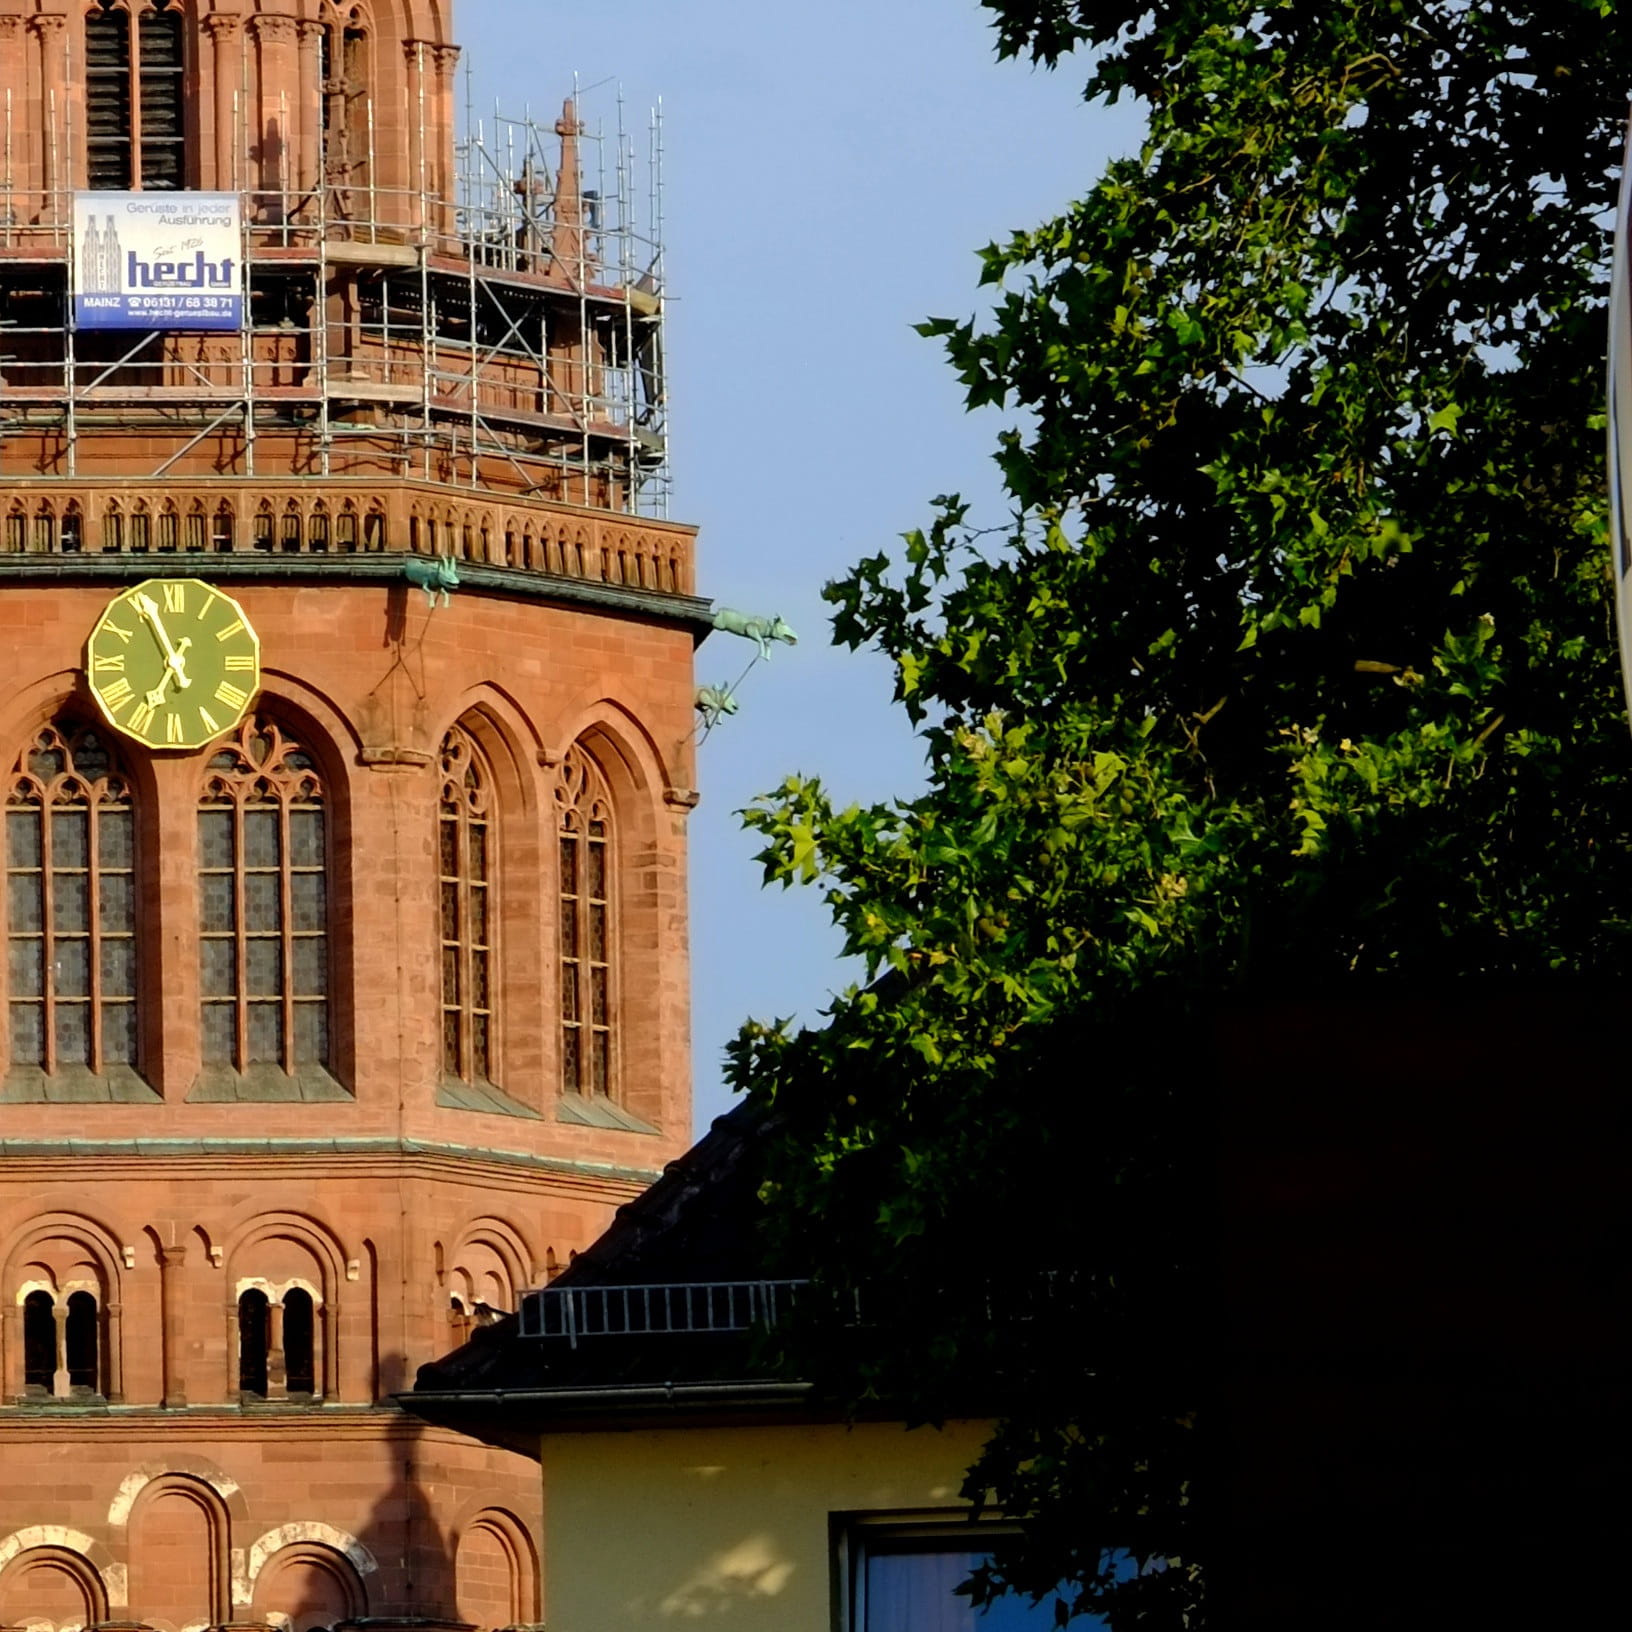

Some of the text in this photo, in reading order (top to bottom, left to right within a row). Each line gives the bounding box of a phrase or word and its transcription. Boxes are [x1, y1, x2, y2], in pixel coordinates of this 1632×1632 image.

[158, 214, 231, 227] Ausführung
[128, 251, 235, 287] hecht
[84, 297, 120, 308] MAINZ
[143, 297, 175, 308] 06131
[221, 297, 233, 308] 71
[163, 584, 184, 613] XII
[102, 619, 134, 644] X
[215, 619, 245, 642] II
[225, 656, 254, 671] III
[199, 706, 220, 734] V
